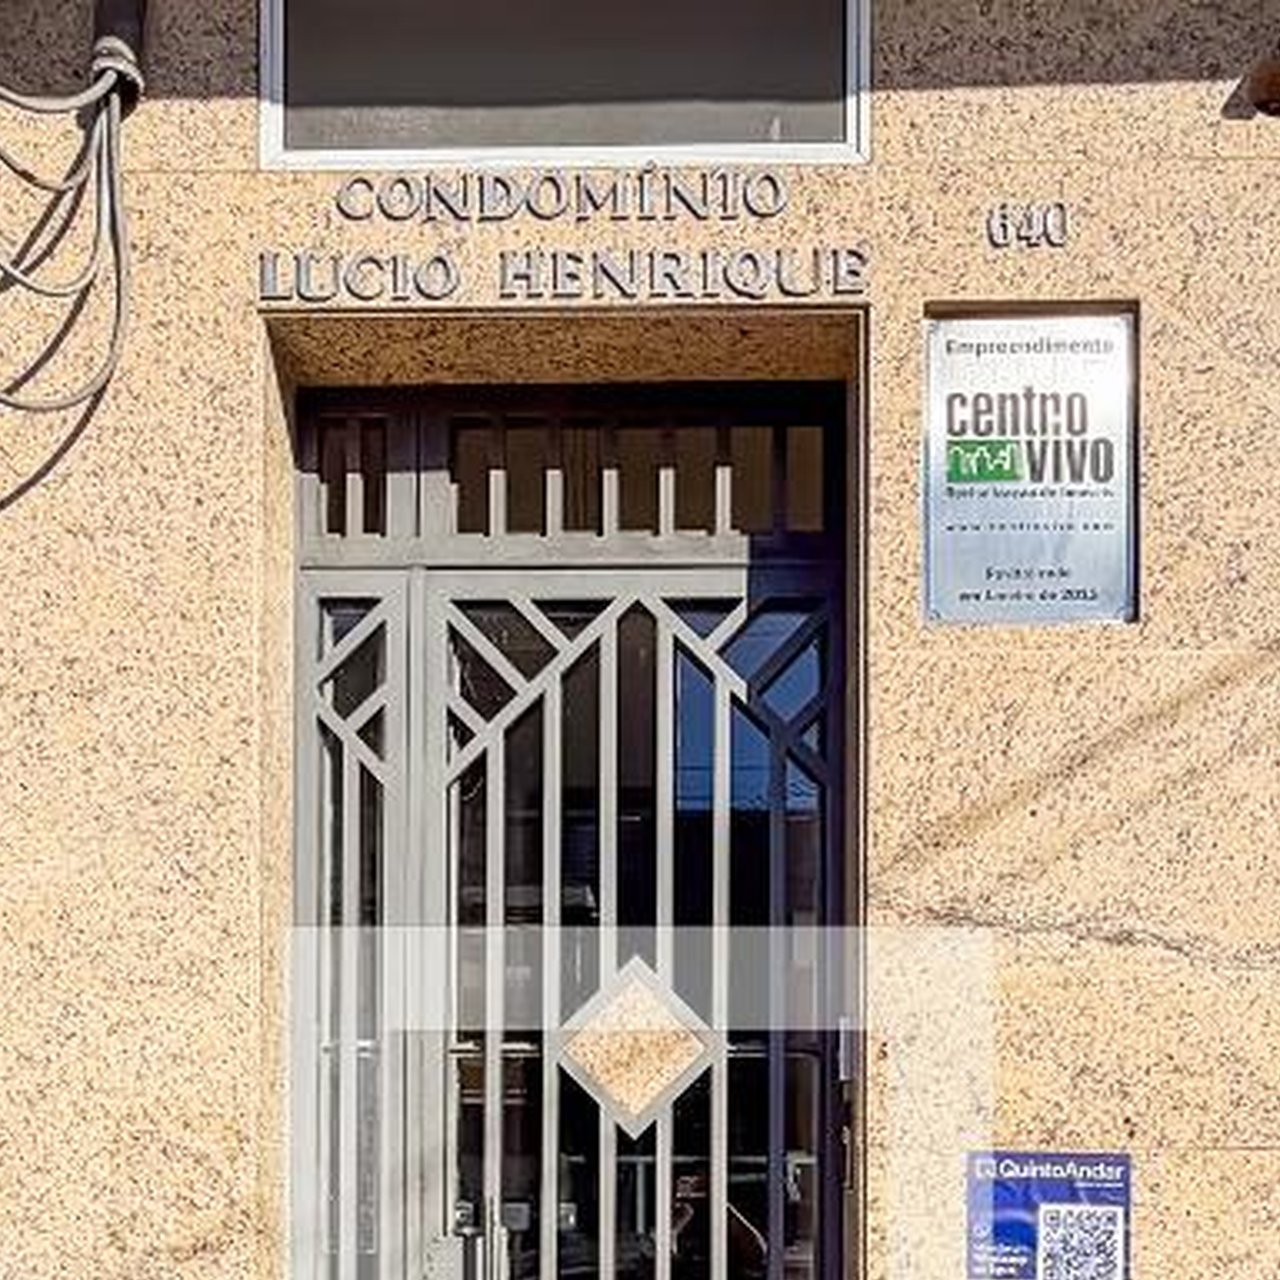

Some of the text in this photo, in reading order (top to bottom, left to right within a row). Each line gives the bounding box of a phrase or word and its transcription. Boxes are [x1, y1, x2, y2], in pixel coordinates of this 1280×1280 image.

[334, 163, 789, 222] CONDOMÍNIO
[986, 202, 1067, 248] 640
[497, 248, 871, 300] HENRIQUE
[945, 386, 1089, 437] centro
[998, 1158, 1125, 1181] QuintoAndar
